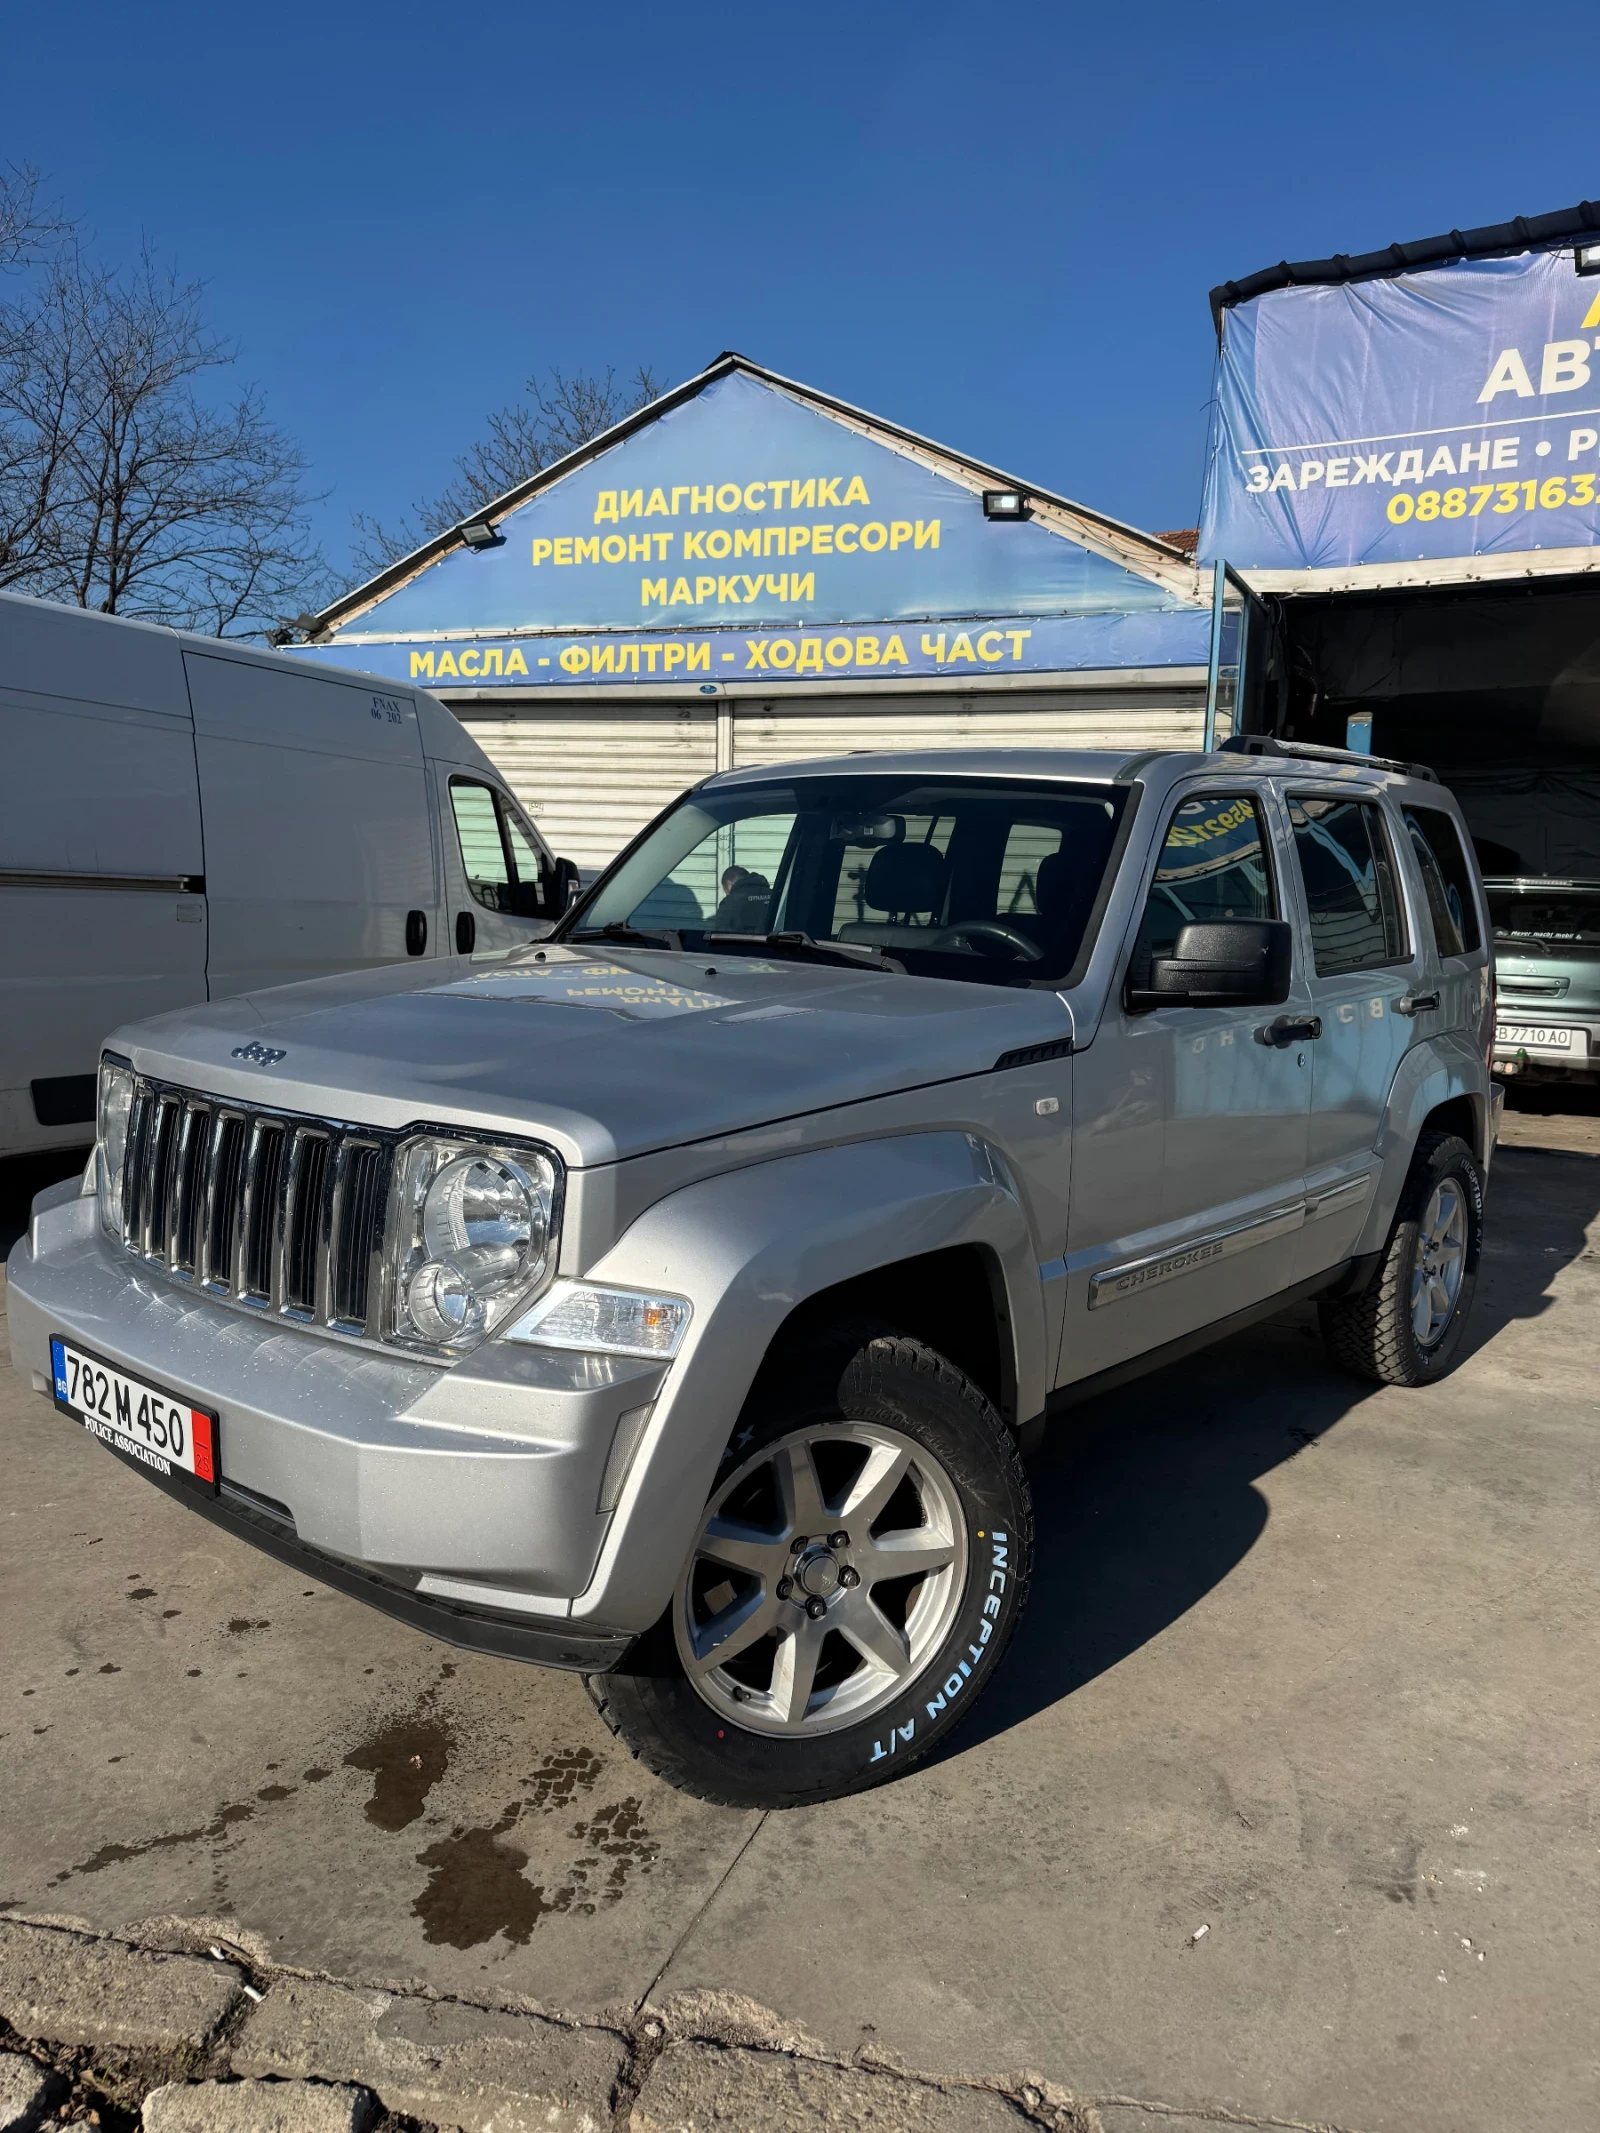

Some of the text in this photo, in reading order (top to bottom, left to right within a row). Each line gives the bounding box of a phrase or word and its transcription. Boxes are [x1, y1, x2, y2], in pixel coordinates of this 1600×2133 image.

[1245, 428, 1600, 493] ЗАРЕЖДАНЕ Р
[593, 476, 870, 524] ДИАГНОСТИКА
[1386, 473, 1600, 525] 08873163
[532, 520, 941, 566] РЕМОНТ КОМПРЕСОРИ
[641, 572, 816, 607] МАРКУЧИ
[409, 648, 529, 678] МАСЛА
[559, 642, 711, 675] ФИЛТРИ
[745, 634, 909, 674] ХОДОВА
[921, 630, 1032, 664] ЧАСТ
[1115, 1241, 1225, 1291] CHEROKEE
[56, 1377, 68, 1395] BG
[84, 1414, 172, 1477] POLICE ASSOCIATION
[925, 1531, 1008, 1720] INCEPTION
[870, 1717, 915, 1763] A/T
